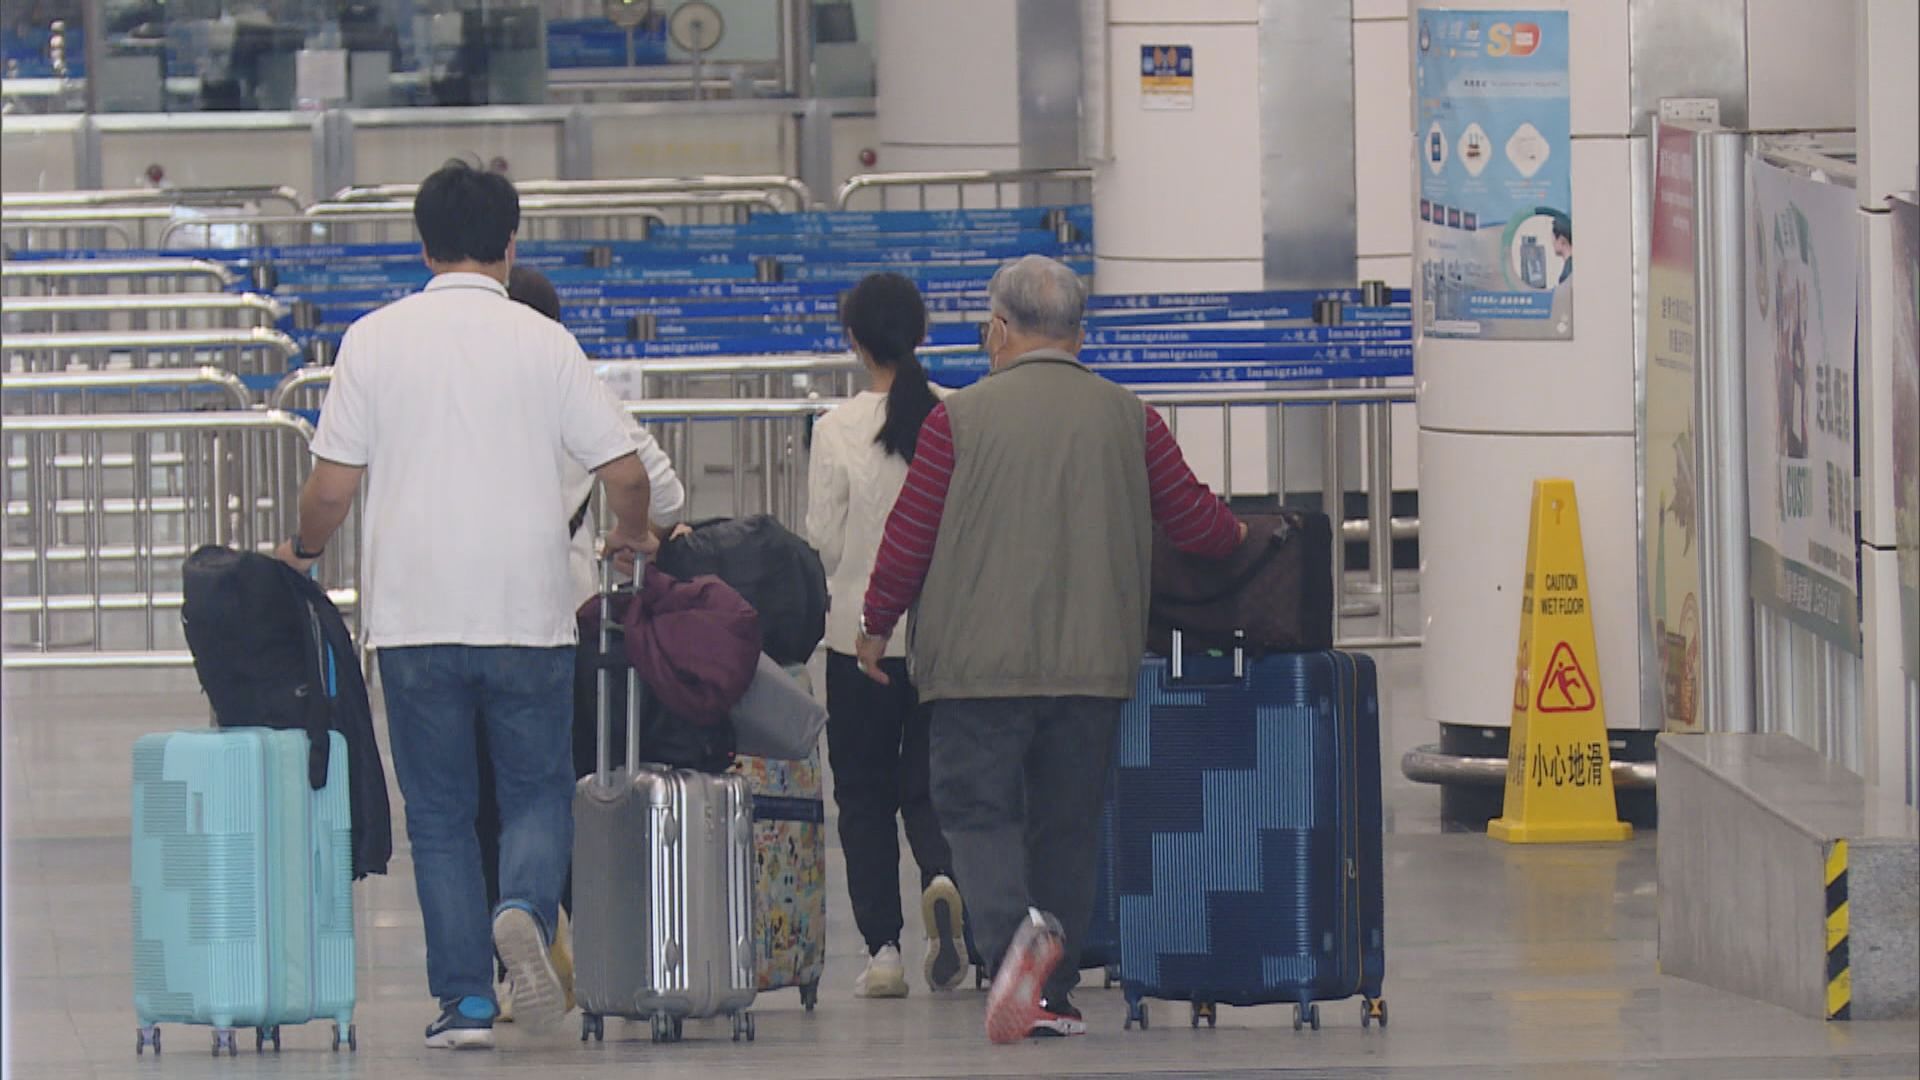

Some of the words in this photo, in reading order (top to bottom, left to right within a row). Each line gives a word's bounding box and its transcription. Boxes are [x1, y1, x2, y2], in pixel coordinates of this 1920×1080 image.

[1158, 295, 1229, 306] Immigration
[1227, 307, 1288, 319] Immigration
[1116, 331, 1189, 342] Immigration
[1328, 328, 1402, 341] Immigration
[645, 342, 719, 354] Immigration
[1142, 349, 1218, 361] Immigration
[1247, 366, 1323, 379] Immigration
[1546, 573, 1578, 591] CAUTION
[1541, 598, 1558, 615] WET
[1559, 598, 1584, 615] FLOOR
[1531, 742, 1603, 787] 小心地滑
